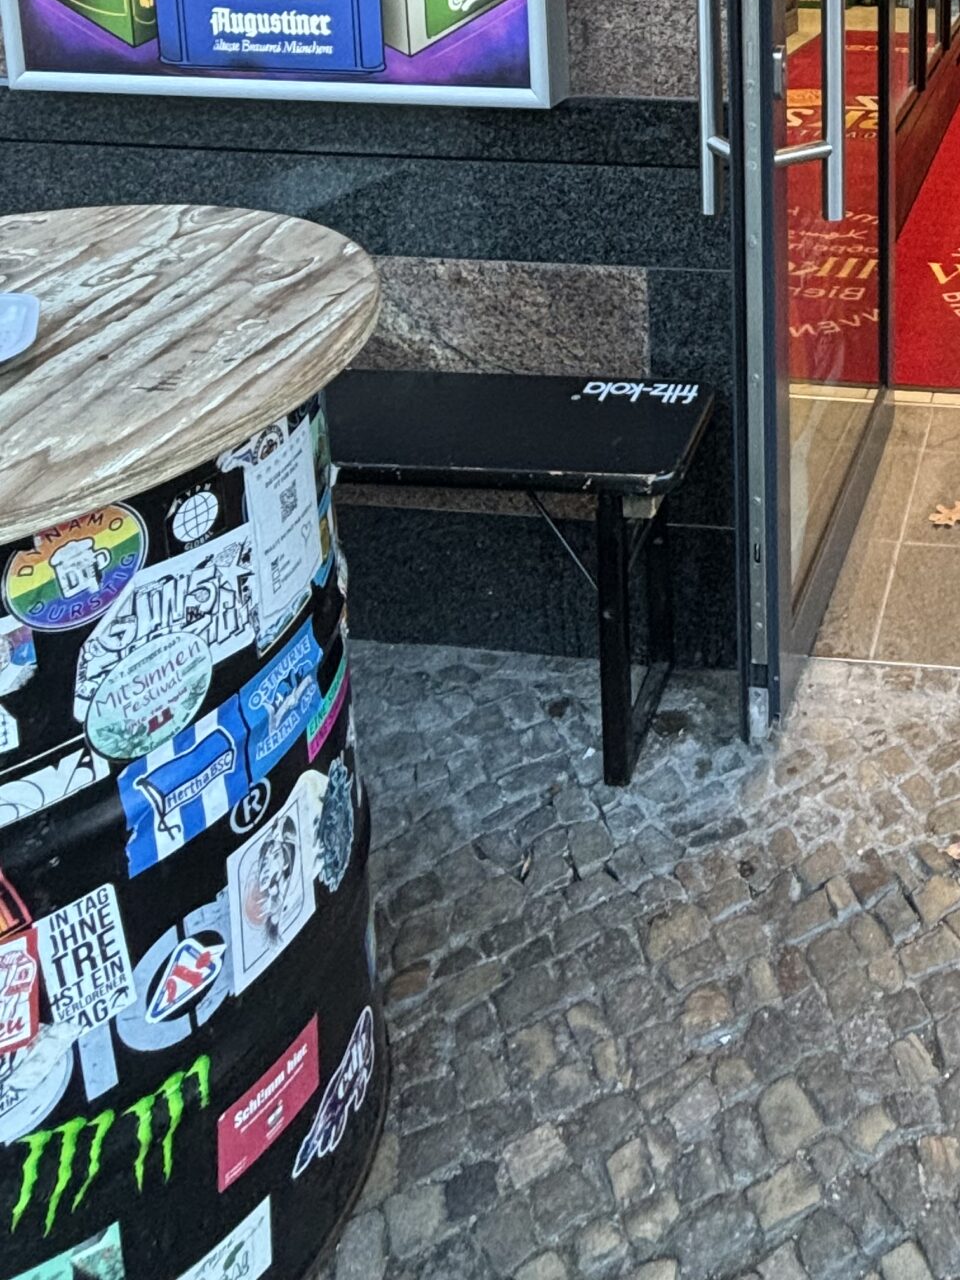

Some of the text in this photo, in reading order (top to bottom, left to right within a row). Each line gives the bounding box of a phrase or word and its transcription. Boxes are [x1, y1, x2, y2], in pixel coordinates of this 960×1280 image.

[209, 6, 332, 37] Augustiner
[582, 379, 699, 405] fritz-kola
[184, 530, 214, 551] GLOBAL
[27, 552, 136, 621] DURSTIG
[122, 671, 183, 718] Festival
[256, 711, 300, 760] HERTHA
[73, 887, 110, 918] TAG
[91, 955, 125, 990] EIN
[57, 973, 128, 1021] VERLORENER
[233, 1070, 286, 1129] Schlimm
